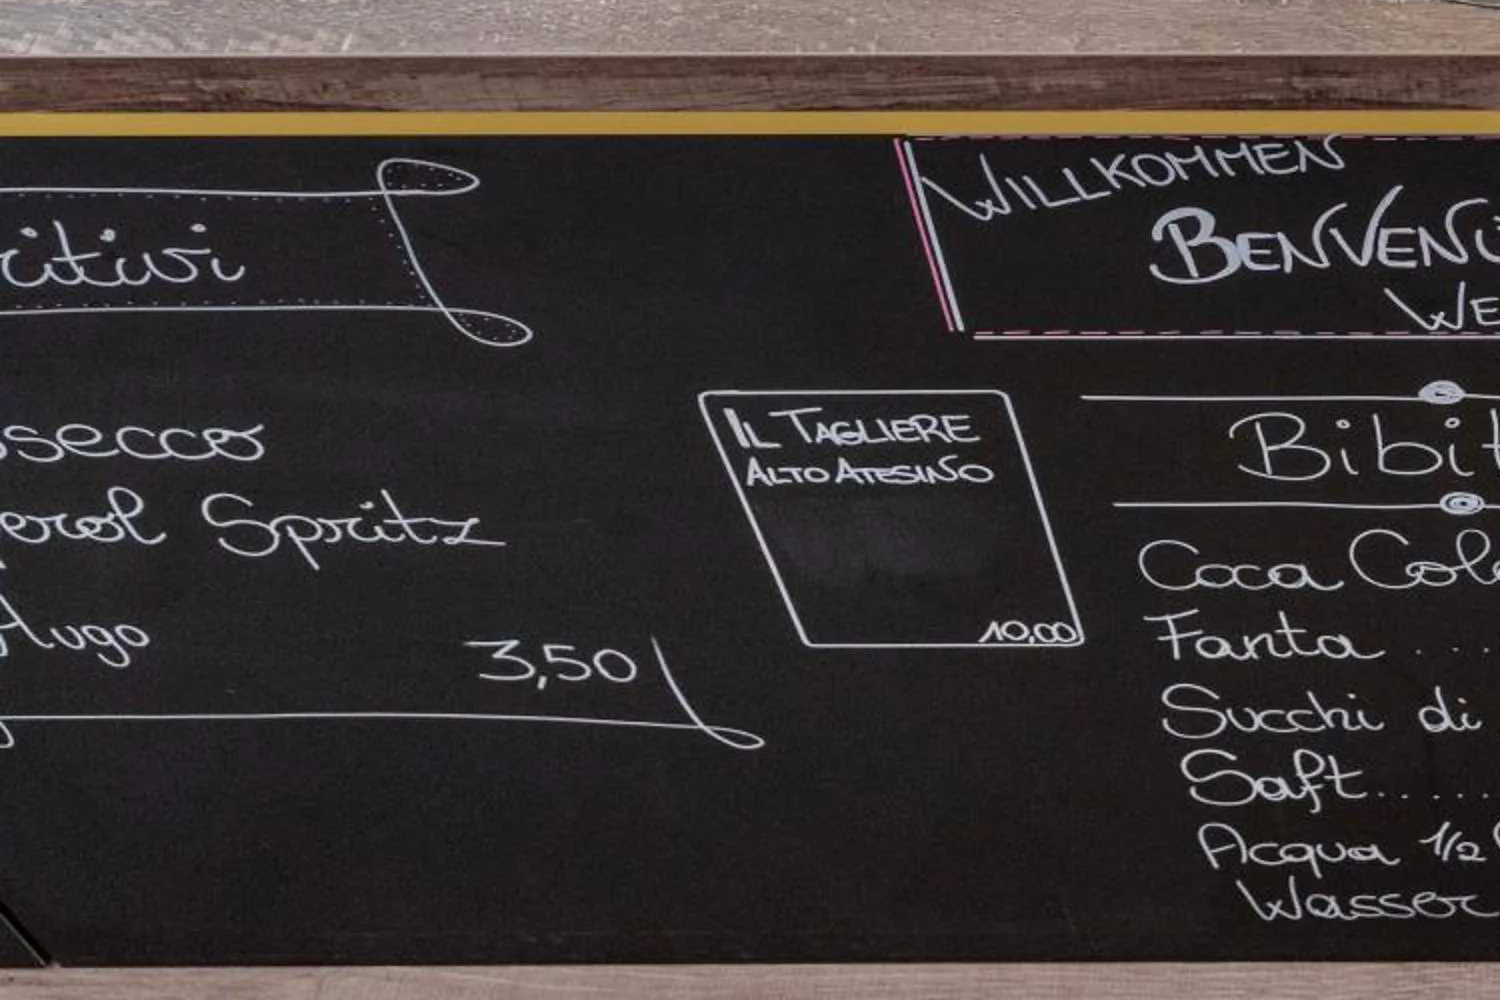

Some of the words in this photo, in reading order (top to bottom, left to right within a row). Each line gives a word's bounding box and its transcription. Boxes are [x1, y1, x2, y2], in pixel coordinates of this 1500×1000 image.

[920, 134, 1345, 222] WILLKOMMEN
[202, 489, 506, 571] Spritz
[1138, 539, 1345, 591] Coca
[1143, 608, 1387, 661] Fanta
[463, 639, 639, 690] 3,50
[1161, 683, 1385, 739] Succhi
[1417, 685, 1483, 734] di
[1180, 748, 1368, 815] Saft
[1197, 822, 1401, 880] Acqua
